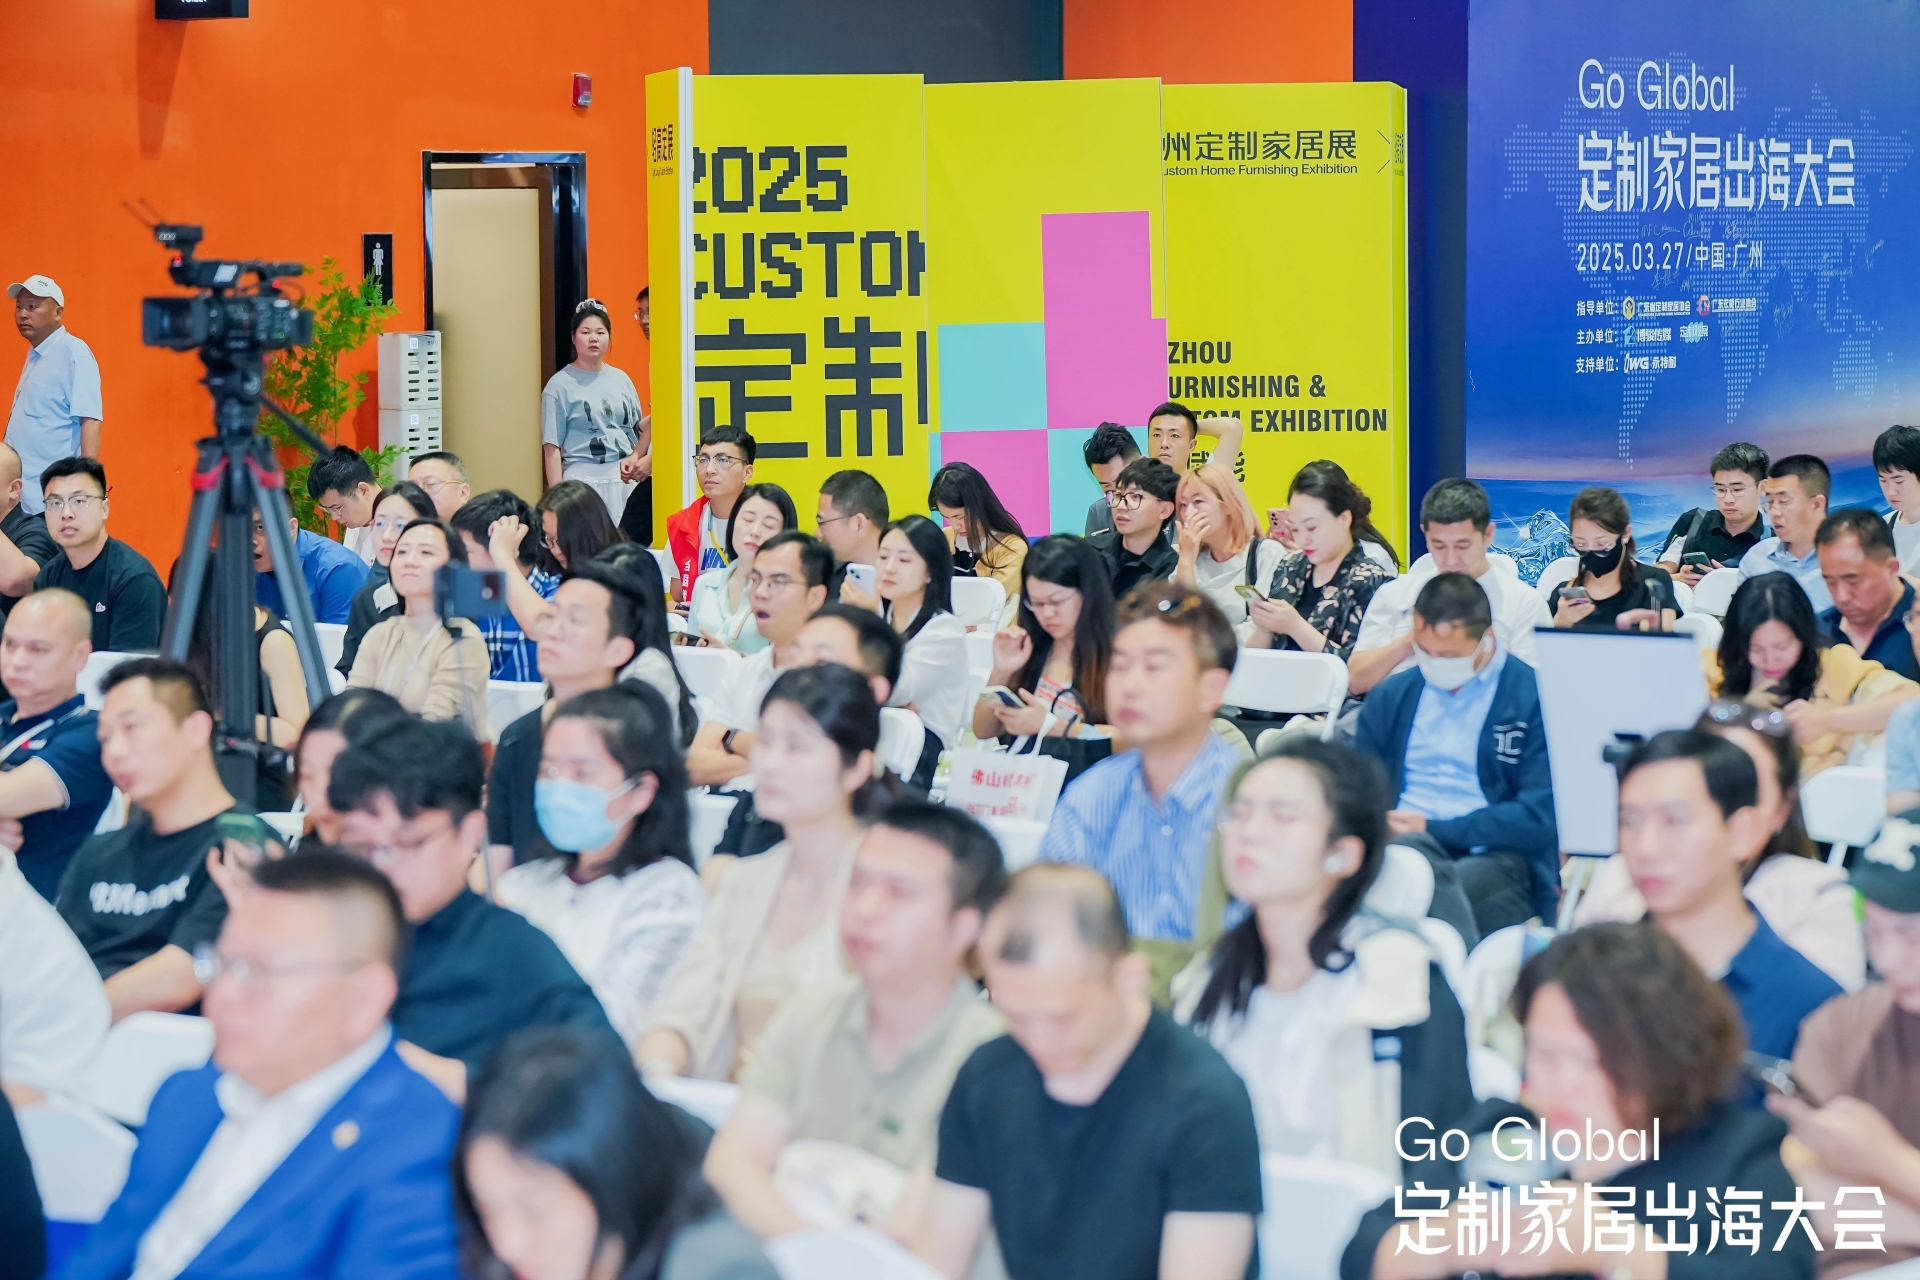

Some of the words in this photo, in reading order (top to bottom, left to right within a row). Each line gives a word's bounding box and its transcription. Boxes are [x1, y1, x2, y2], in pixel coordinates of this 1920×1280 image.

[1578, 58, 1625, 110] Go
[1637, 60, 1734, 111] Global
[1163, 129, 1357, 161] 州定制家居展
[1201, 164, 1236, 176] Home
[1238, 163, 1299, 177] Furnishing
[1301, 162, 1358, 175] Exhibition
[1577, 130, 1856, 213] 定制家居出海大会
[1168, 340, 1232, 364] ZHOU
[1168, 374, 1300, 399] URNISHING
[1309, 373, 1327, 398] &
[1250, 408, 1387, 432] EXHIBITION
